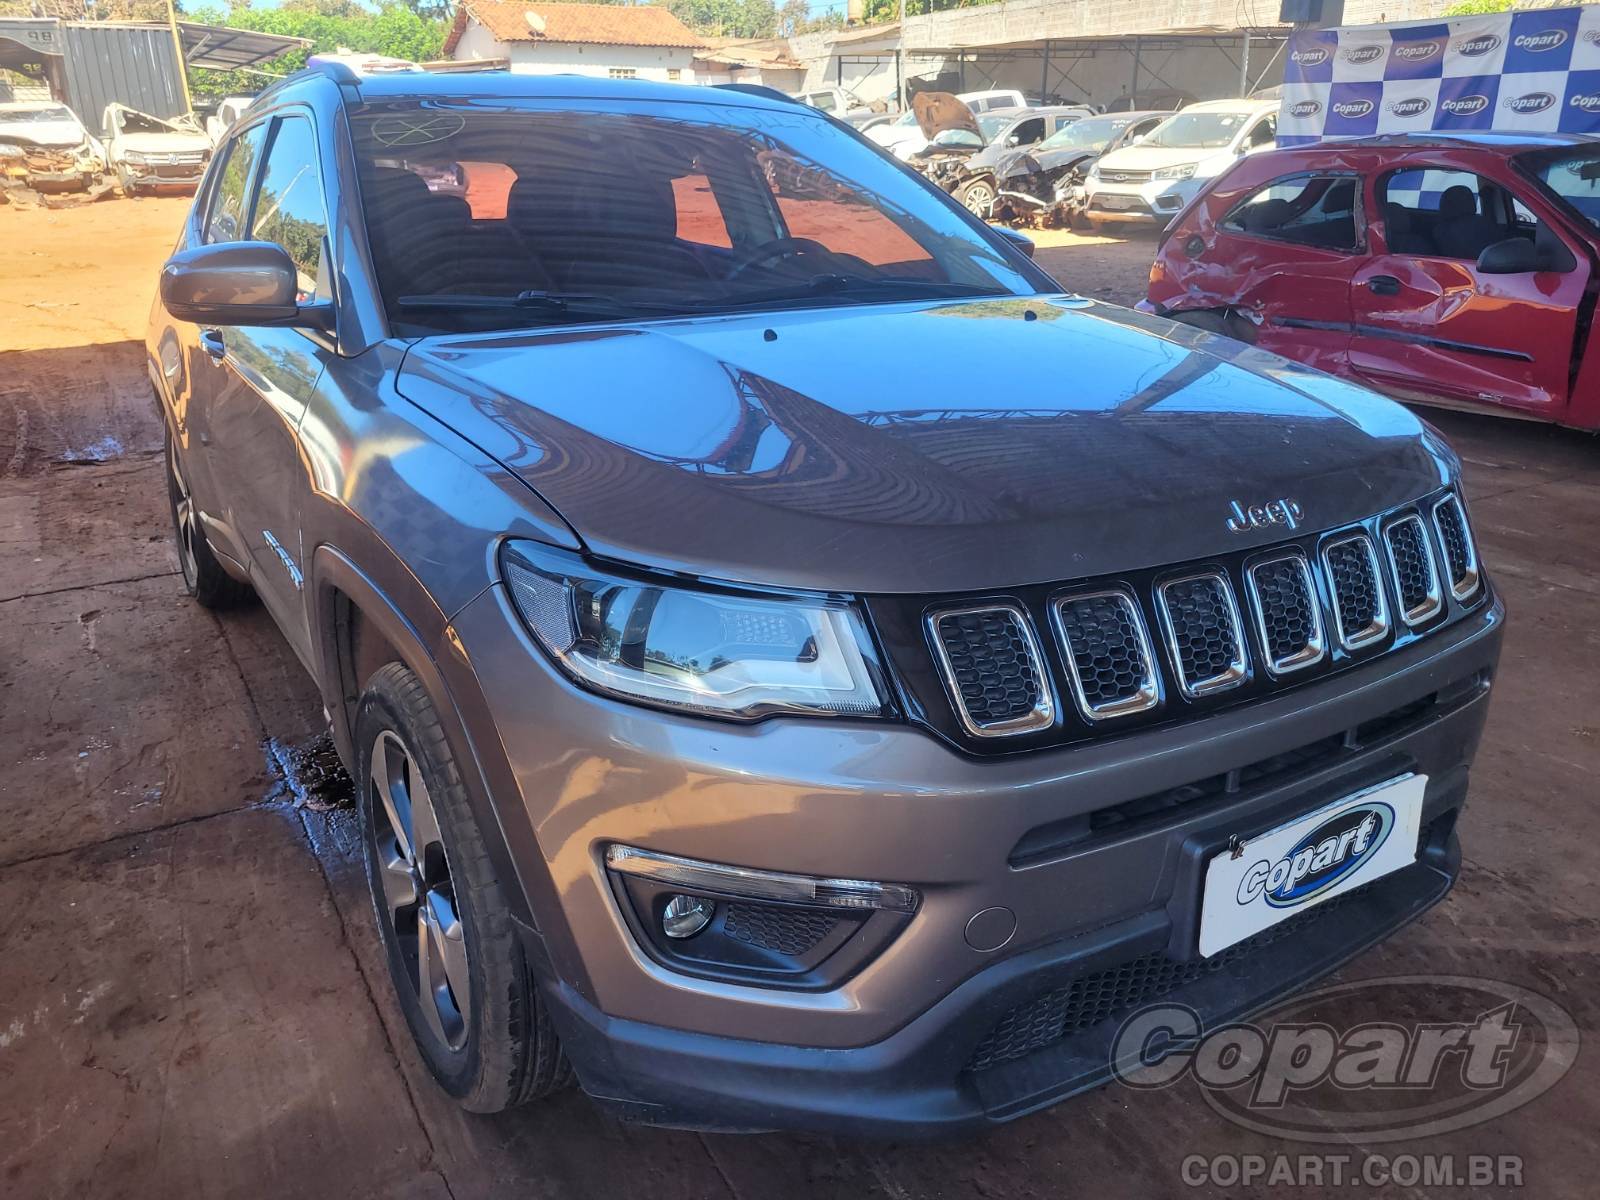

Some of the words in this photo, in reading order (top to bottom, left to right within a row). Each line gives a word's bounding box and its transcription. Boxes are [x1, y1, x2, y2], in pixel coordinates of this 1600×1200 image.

[1453, 38, 1496, 53] Copart
[1514, 32, 1561, 48] Copart
[1291, 49, 1324, 61] Copart
[1394, 44, 1435, 57] Copart
[1332, 100, 1370, 114] Copart
[1385, 100, 1425, 113] Copart
[1441, 98, 1483, 112] Copart
[1503, 96, 1547, 110] Copart
[1225, 498, 1305, 534] Jeep
[1236, 809, 1377, 906] Copart
